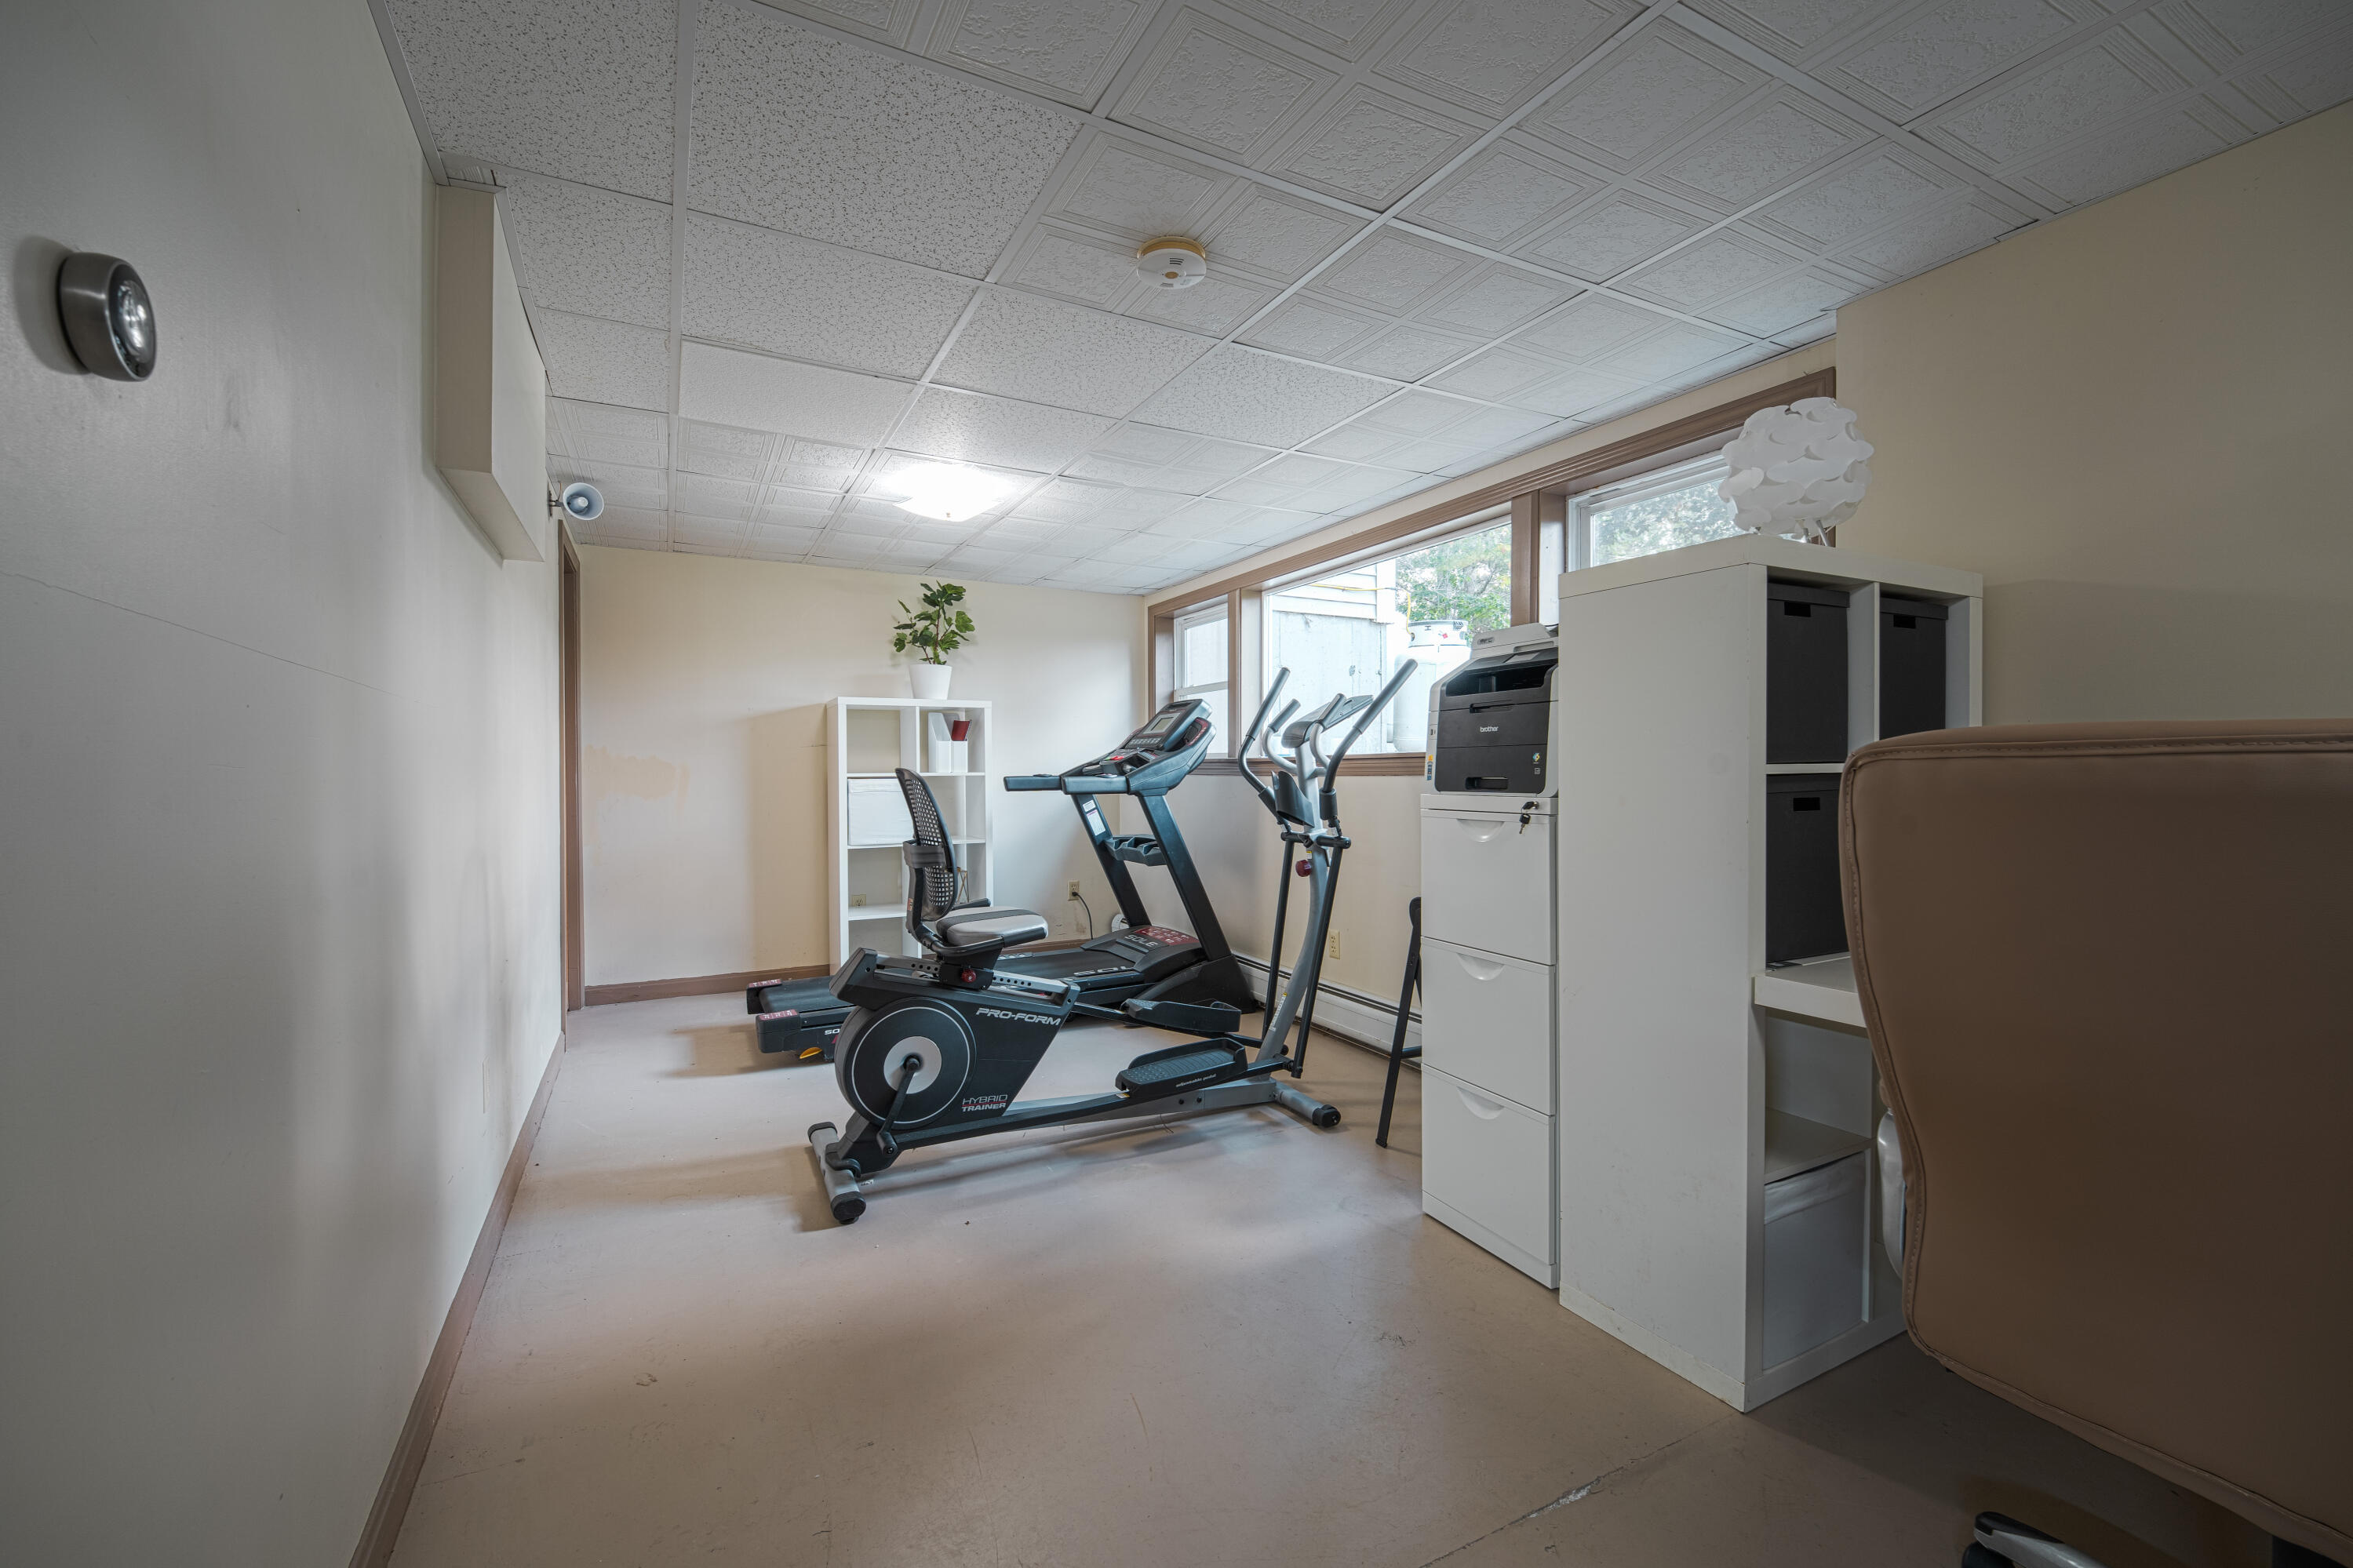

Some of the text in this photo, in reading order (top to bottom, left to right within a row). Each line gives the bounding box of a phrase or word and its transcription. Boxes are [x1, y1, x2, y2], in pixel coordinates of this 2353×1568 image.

[1124, 934, 1159, 948] SOLE
[1073, 966, 1135, 977] SOL
[975, 1007, 1062, 1026] PRO-FORM
[962, 1094, 1008, 1104] HYBRID
[961, 1102, 1007, 1112] TRAINER
